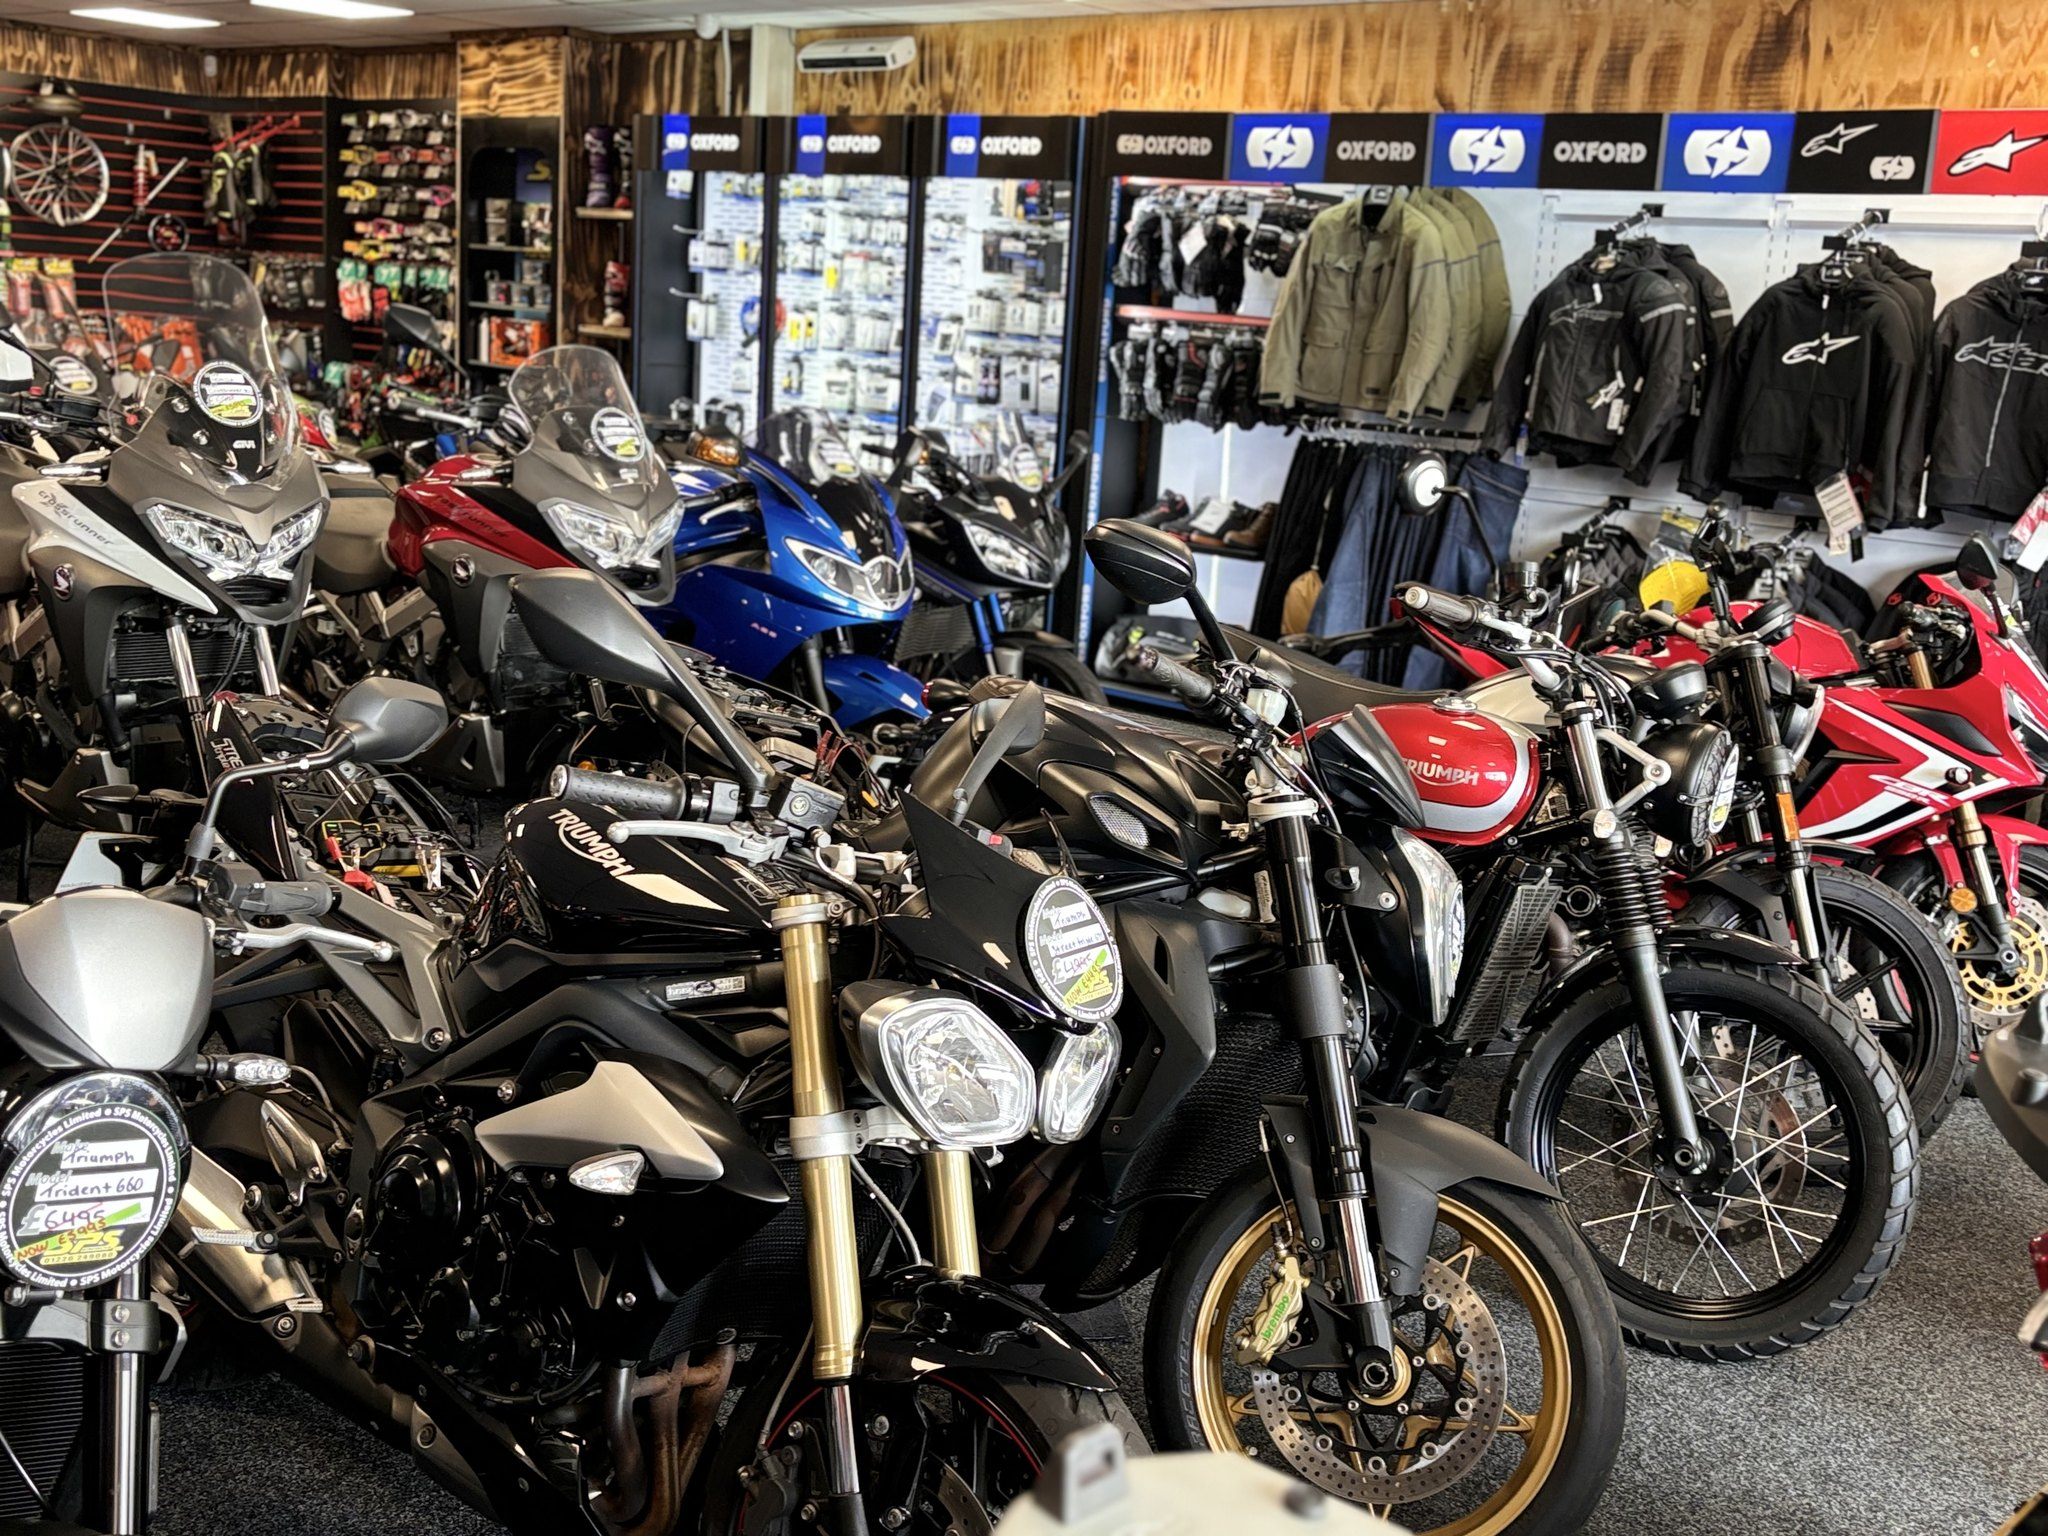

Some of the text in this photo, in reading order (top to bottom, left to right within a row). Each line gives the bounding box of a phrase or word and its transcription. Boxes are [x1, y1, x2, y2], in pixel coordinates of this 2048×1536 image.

[690, 133, 740, 151] OXFORD
[826, 135, 882, 153] OXFORD
[980, 136, 1042, 156] OXFORD
[1144, 135, 1213, 156] OXFORD
[1336, 141, 1416, 162] OXFORD
[1553, 141, 1647, 163] OXFORD
[548, 808, 635, 877] TRIUMPH
[113, 1106, 132, 1116] SPS
[131, 1110, 169, 1148] Motorcycles
[2, 1106, 102, 1197] SPS Motorcycles Limited
[25, 1169, 74, 1186] Model
[40, 1176, 144, 1198] Trident 660
[17, 1241, 49, 1261] NOW
[80, 1273, 101, 1286] SPS
[101, 1235, 155, 1280] Motorcycles
[30, 1272, 69, 1288] Limited
[1262, 1294, 1289, 1341] brembo
